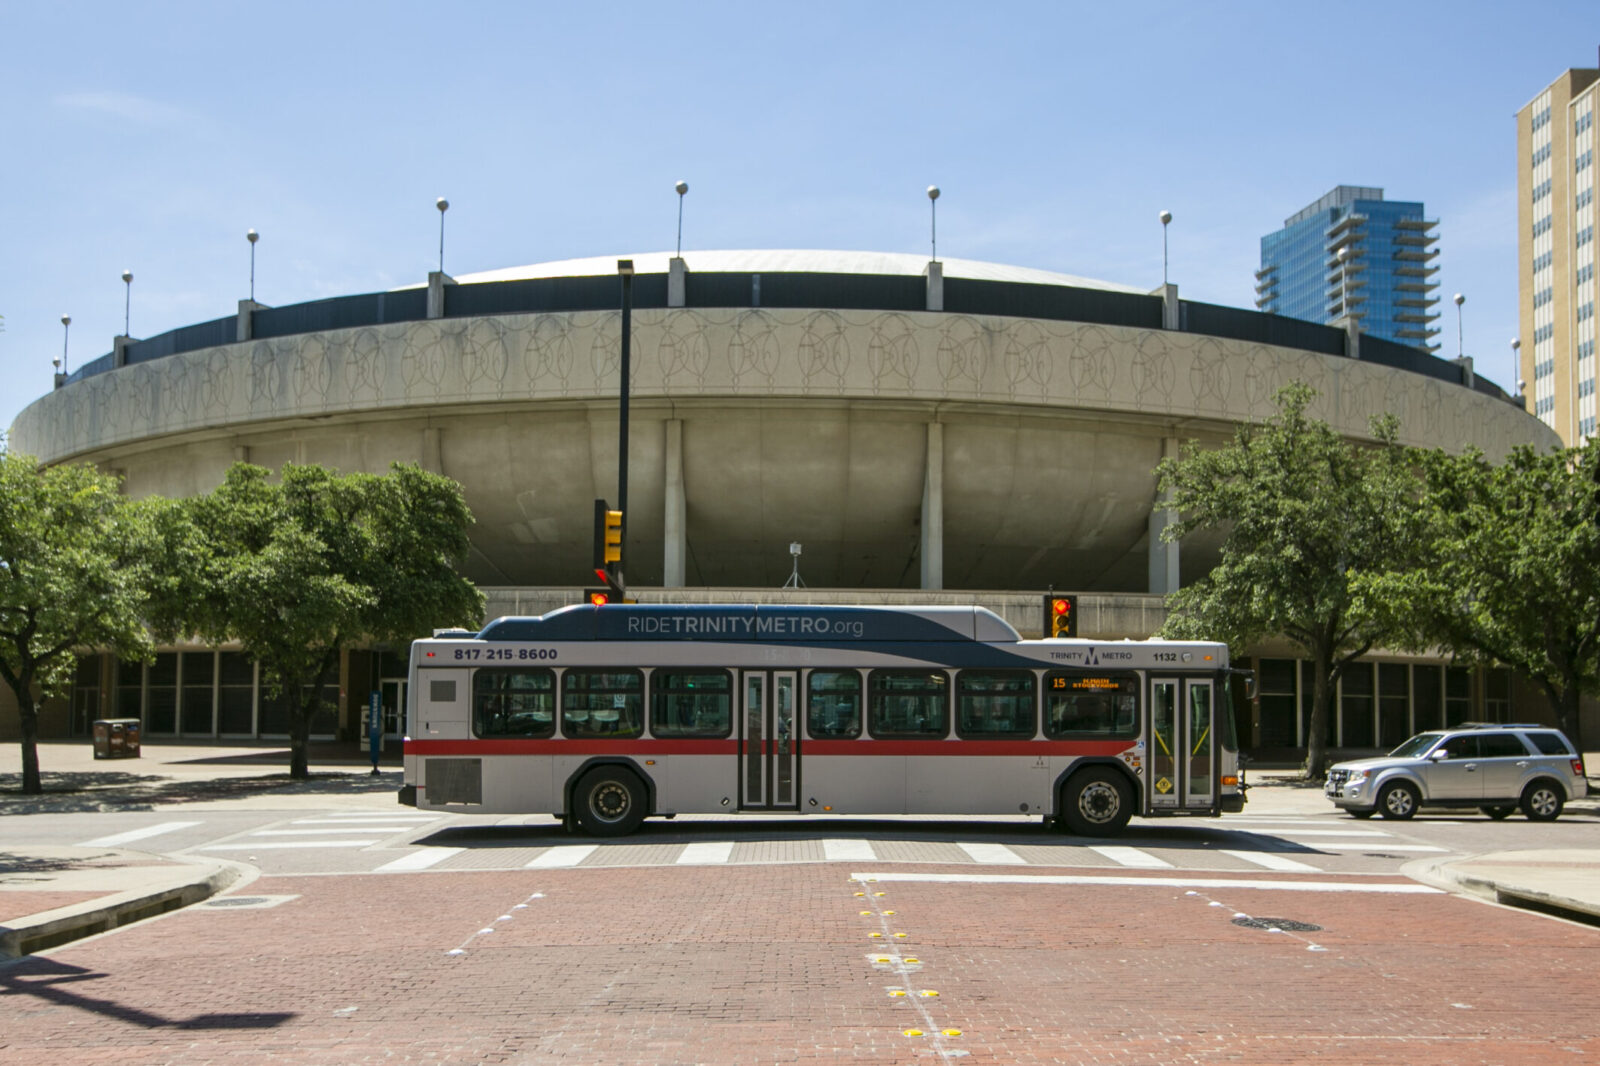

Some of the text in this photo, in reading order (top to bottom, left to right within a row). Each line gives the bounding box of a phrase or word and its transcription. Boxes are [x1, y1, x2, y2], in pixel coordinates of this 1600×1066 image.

[628, 616, 864, 638] RIDETRINITYMETRO.org
[1050, 652, 1133, 660] TRINITY METRO
[1153, 653, 1177, 661] 1132
[1053, 678, 1066, 688] 15
